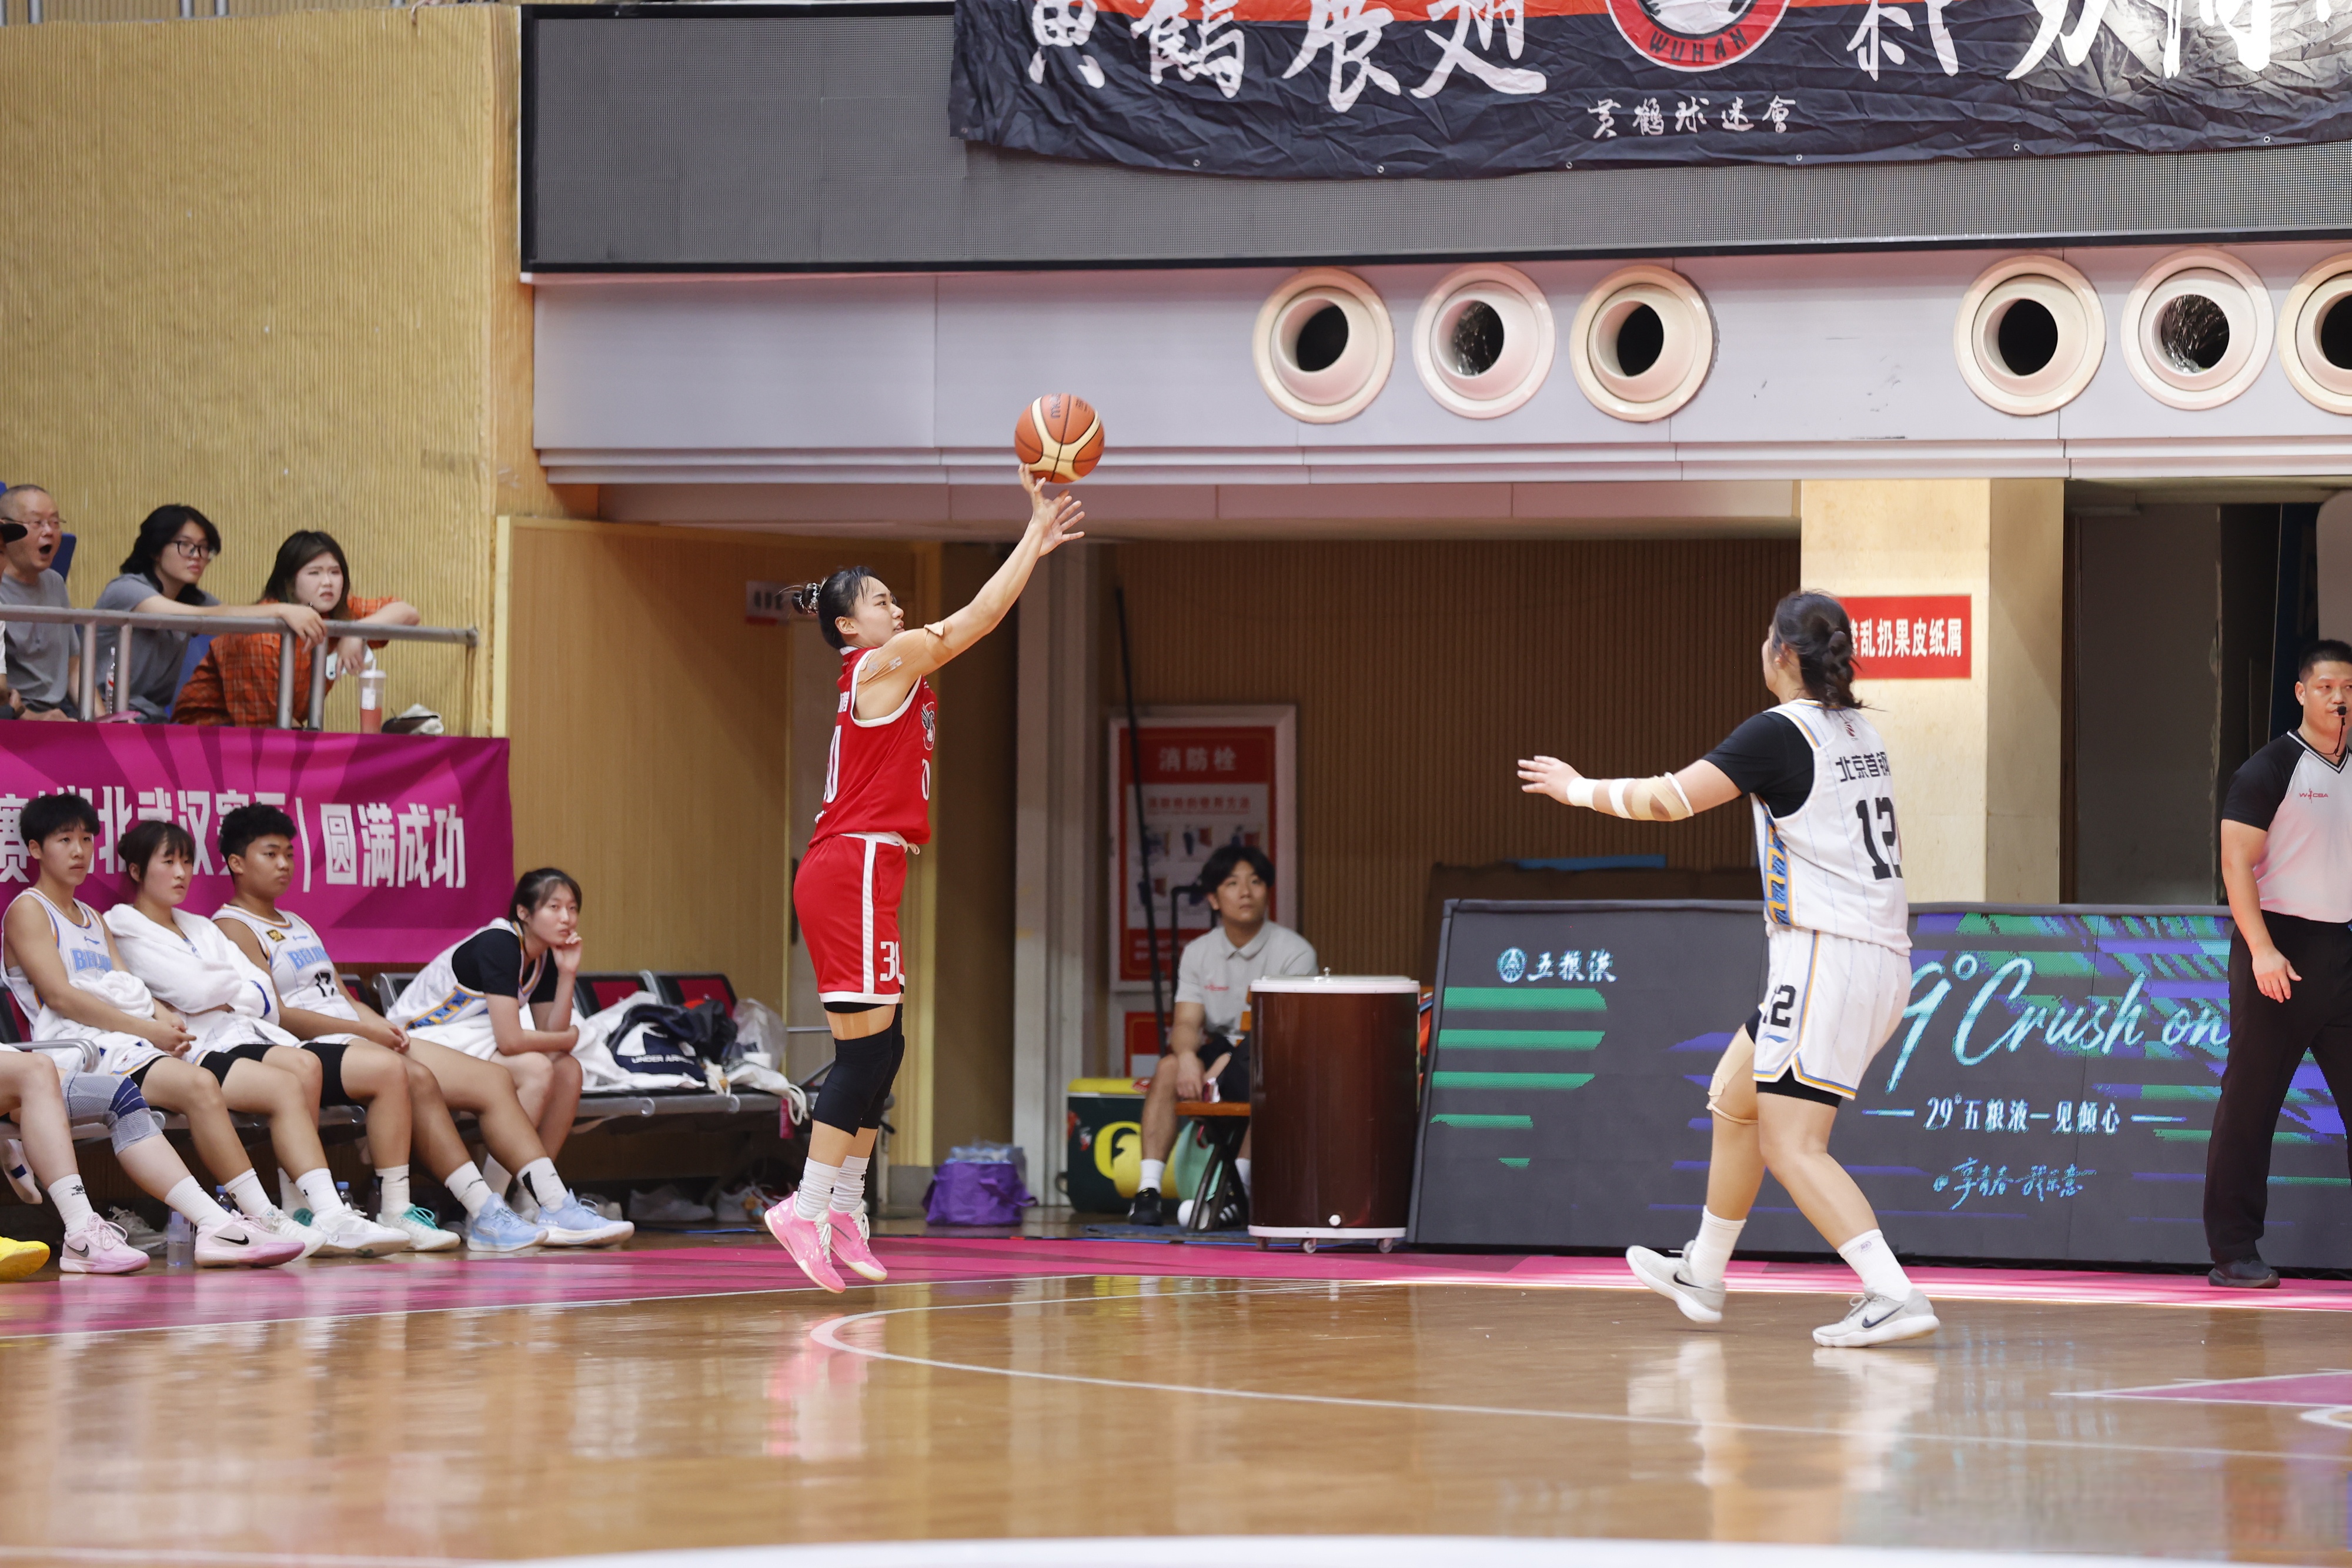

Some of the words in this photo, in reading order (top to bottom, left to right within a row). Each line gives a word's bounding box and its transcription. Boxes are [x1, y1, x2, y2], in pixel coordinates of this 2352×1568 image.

[1649, 28, 1748, 63] WUHAN
[1856, 797, 1904, 881] 12
[1763, 984, 1797, 1029] 2
